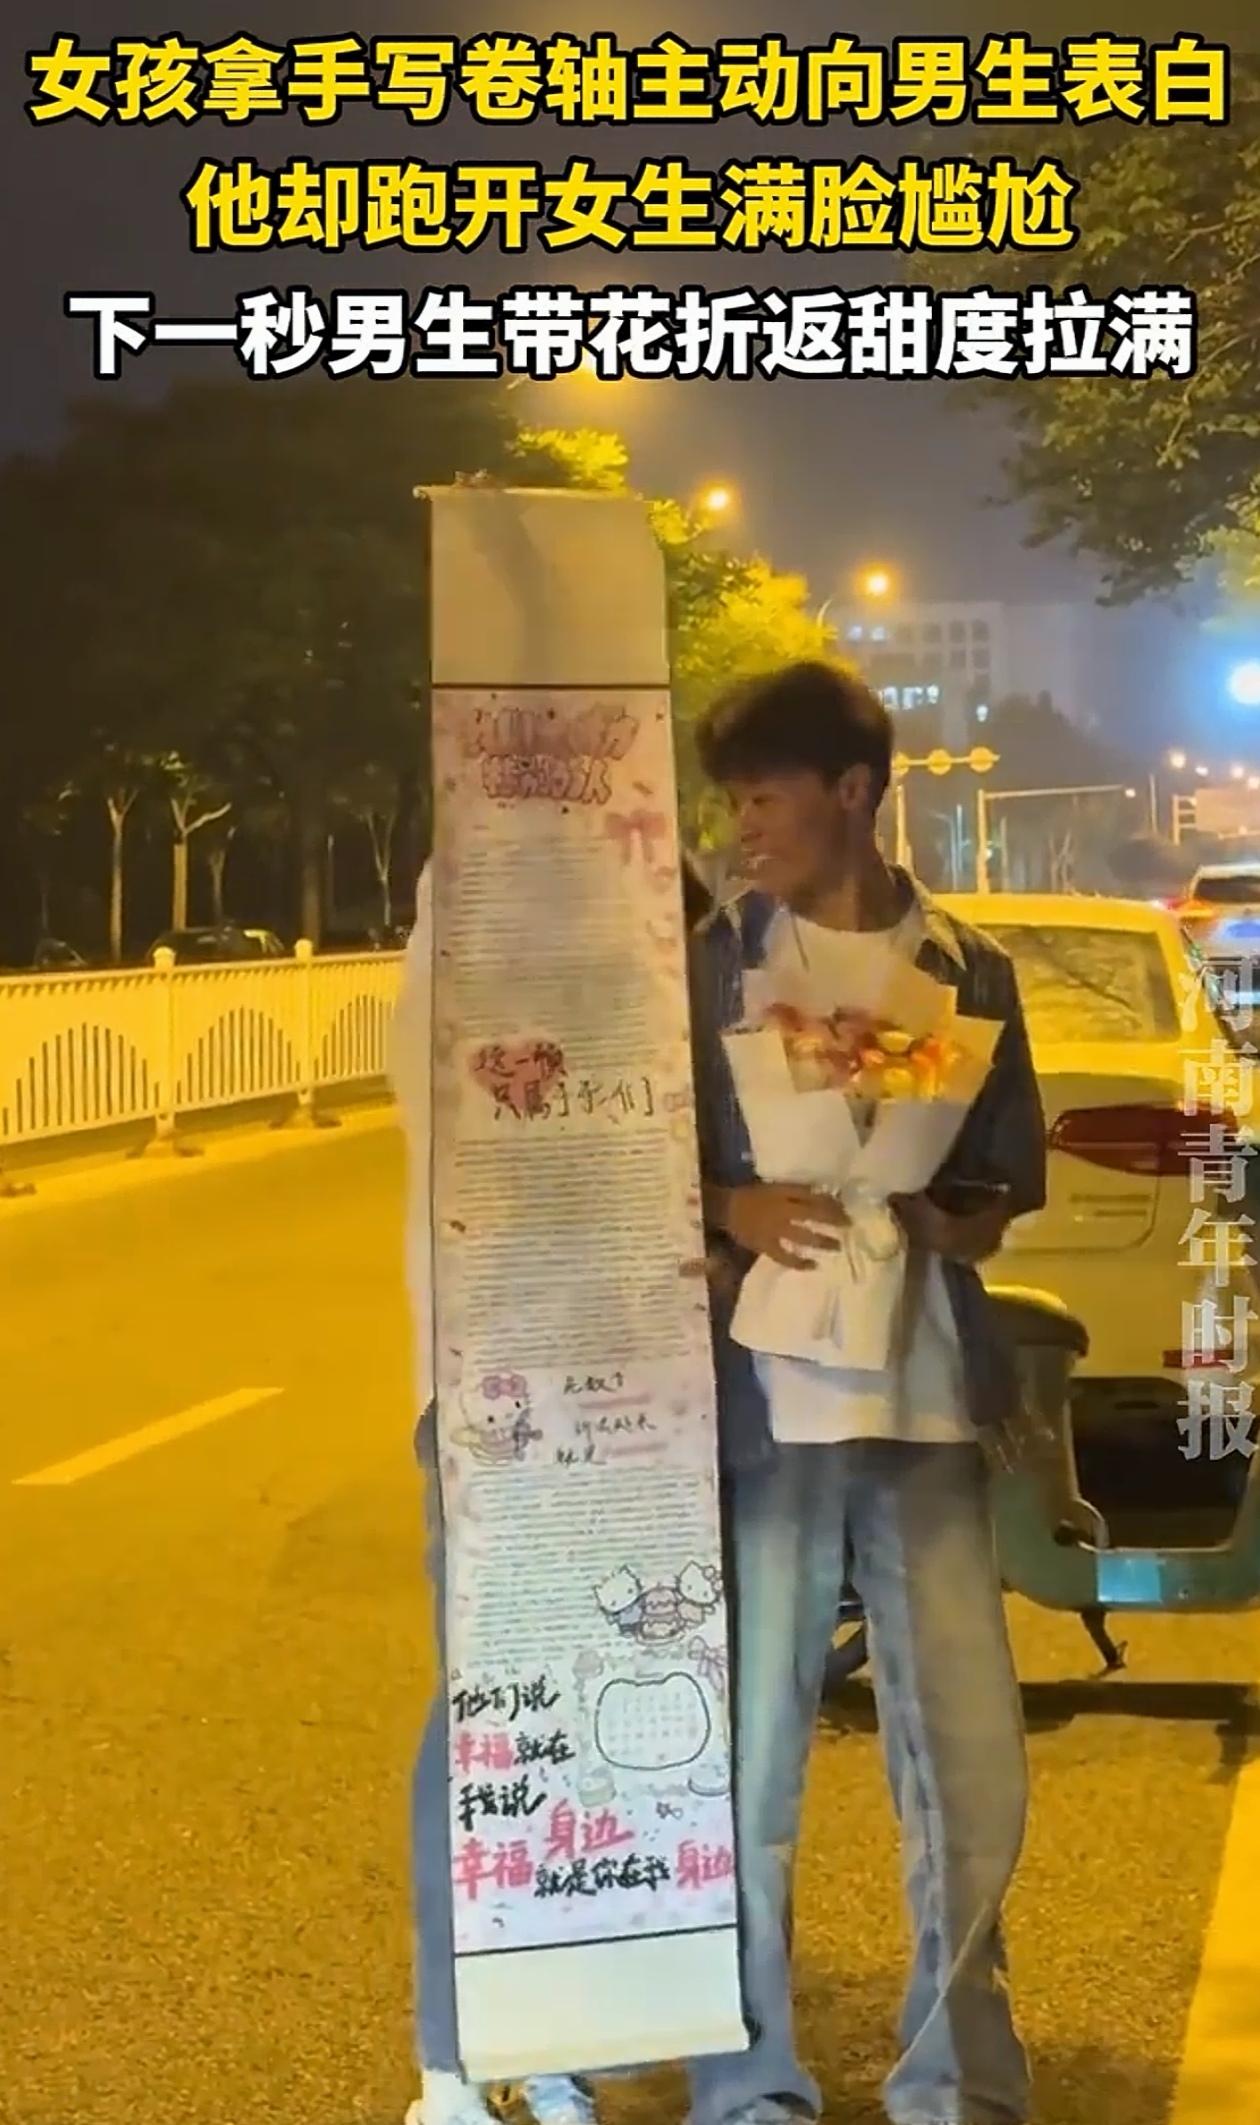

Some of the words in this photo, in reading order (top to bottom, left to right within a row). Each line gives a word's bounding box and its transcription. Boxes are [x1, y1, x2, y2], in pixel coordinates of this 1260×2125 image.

[452, 1675, 560, 1722] 他们说
[455, 1729, 575, 1772] 幸福就在
[459, 1774, 547, 1832] 我说
[545, 1798, 636, 1860] 身边
